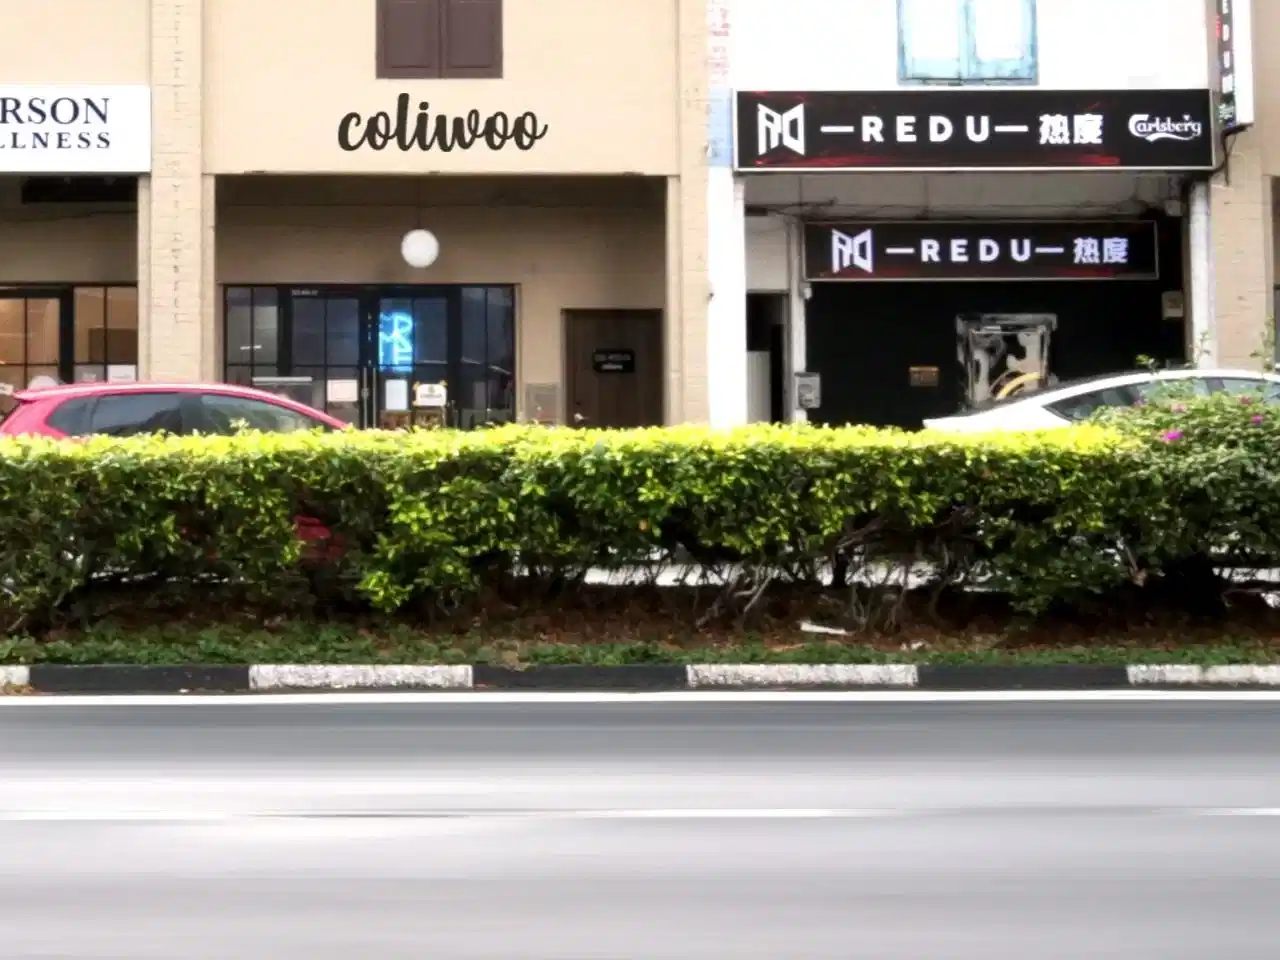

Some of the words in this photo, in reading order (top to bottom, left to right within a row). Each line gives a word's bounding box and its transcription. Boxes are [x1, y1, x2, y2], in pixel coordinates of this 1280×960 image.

[337, 92, 549, 153] coliwoo
[1039, 113, 1104, 145] 热度
[1127, 113, 1202, 139] Carlsberg
[1073, 237, 1128, 264] 热度
